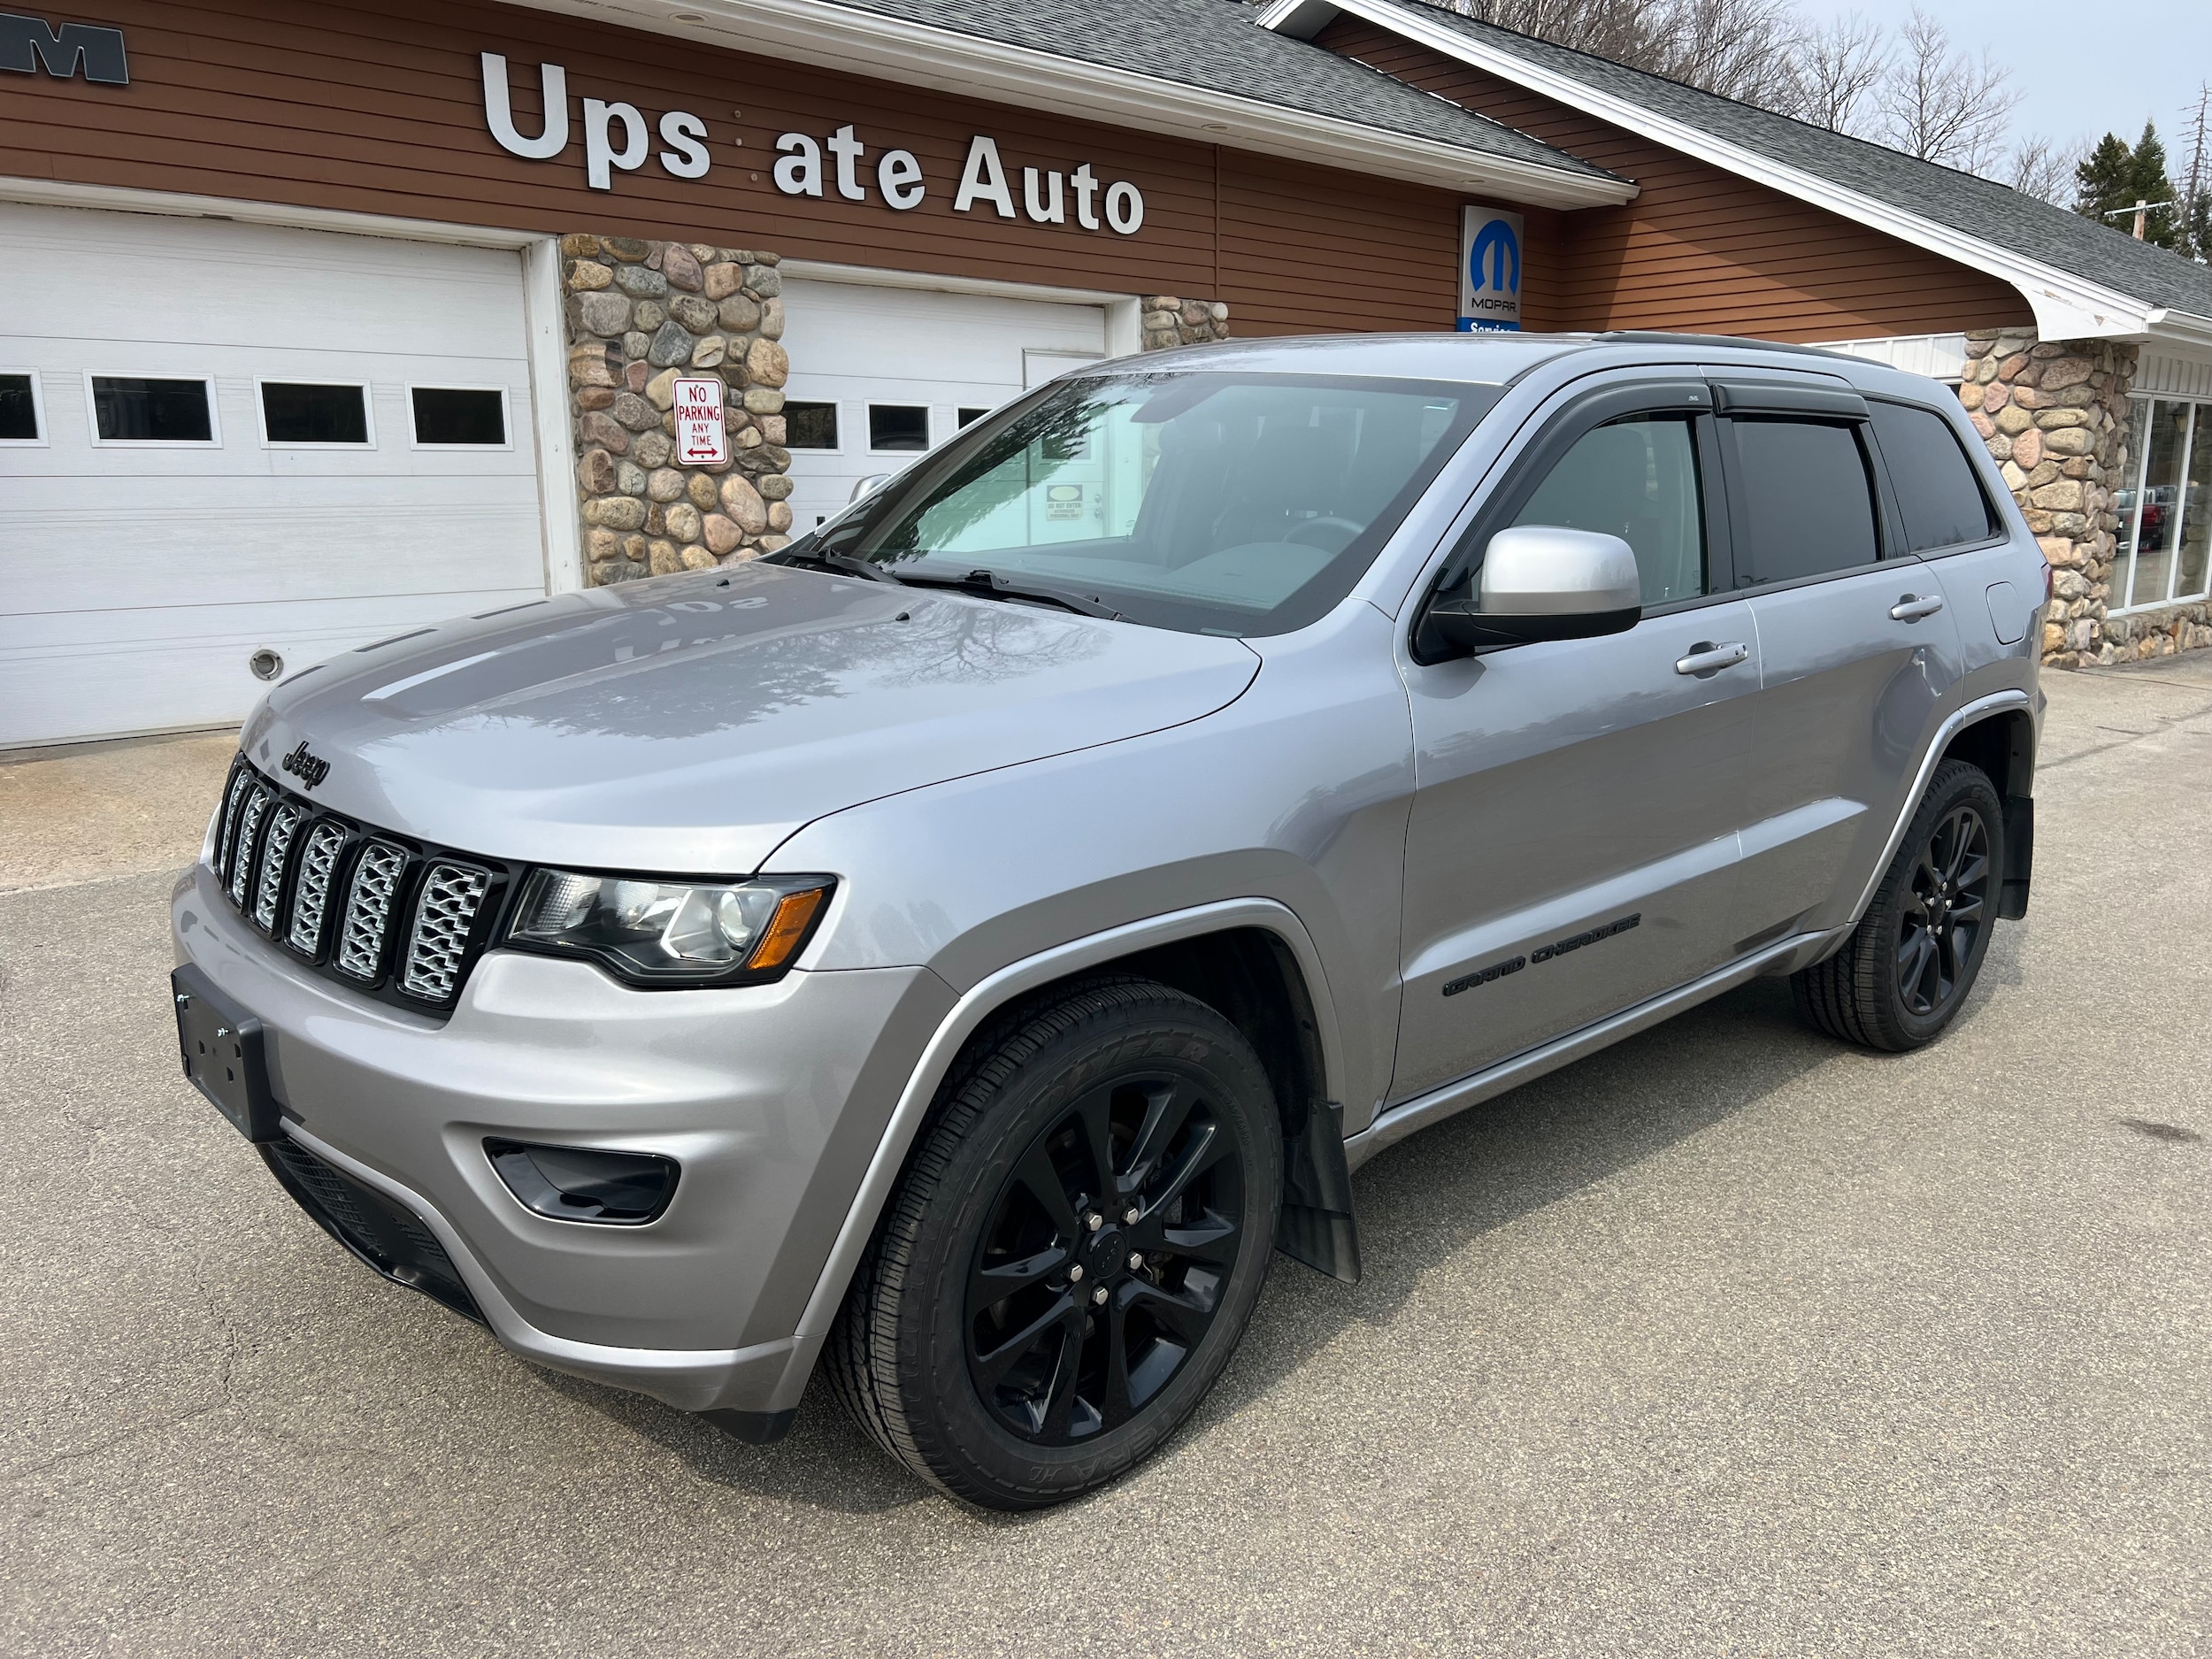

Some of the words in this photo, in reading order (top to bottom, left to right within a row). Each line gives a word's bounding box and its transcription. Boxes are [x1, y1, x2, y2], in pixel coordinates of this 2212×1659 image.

[480, 51, 711, 190] Ups
[773, 124, 926, 211] ate
[954, 135, 1144, 235] Auto
[1471, 297, 1517, 312] MOPAR
[688, 387, 707, 403] NO
[679, 405, 720, 420] PARKING
[692, 423, 710, 434] ANY
[691, 435, 712, 446] TIME
[282, 740, 331, 792] Jeep
[1442, 956, 1526, 997] GRAND
[1531, 913, 1641, 964] CHEROKEE
